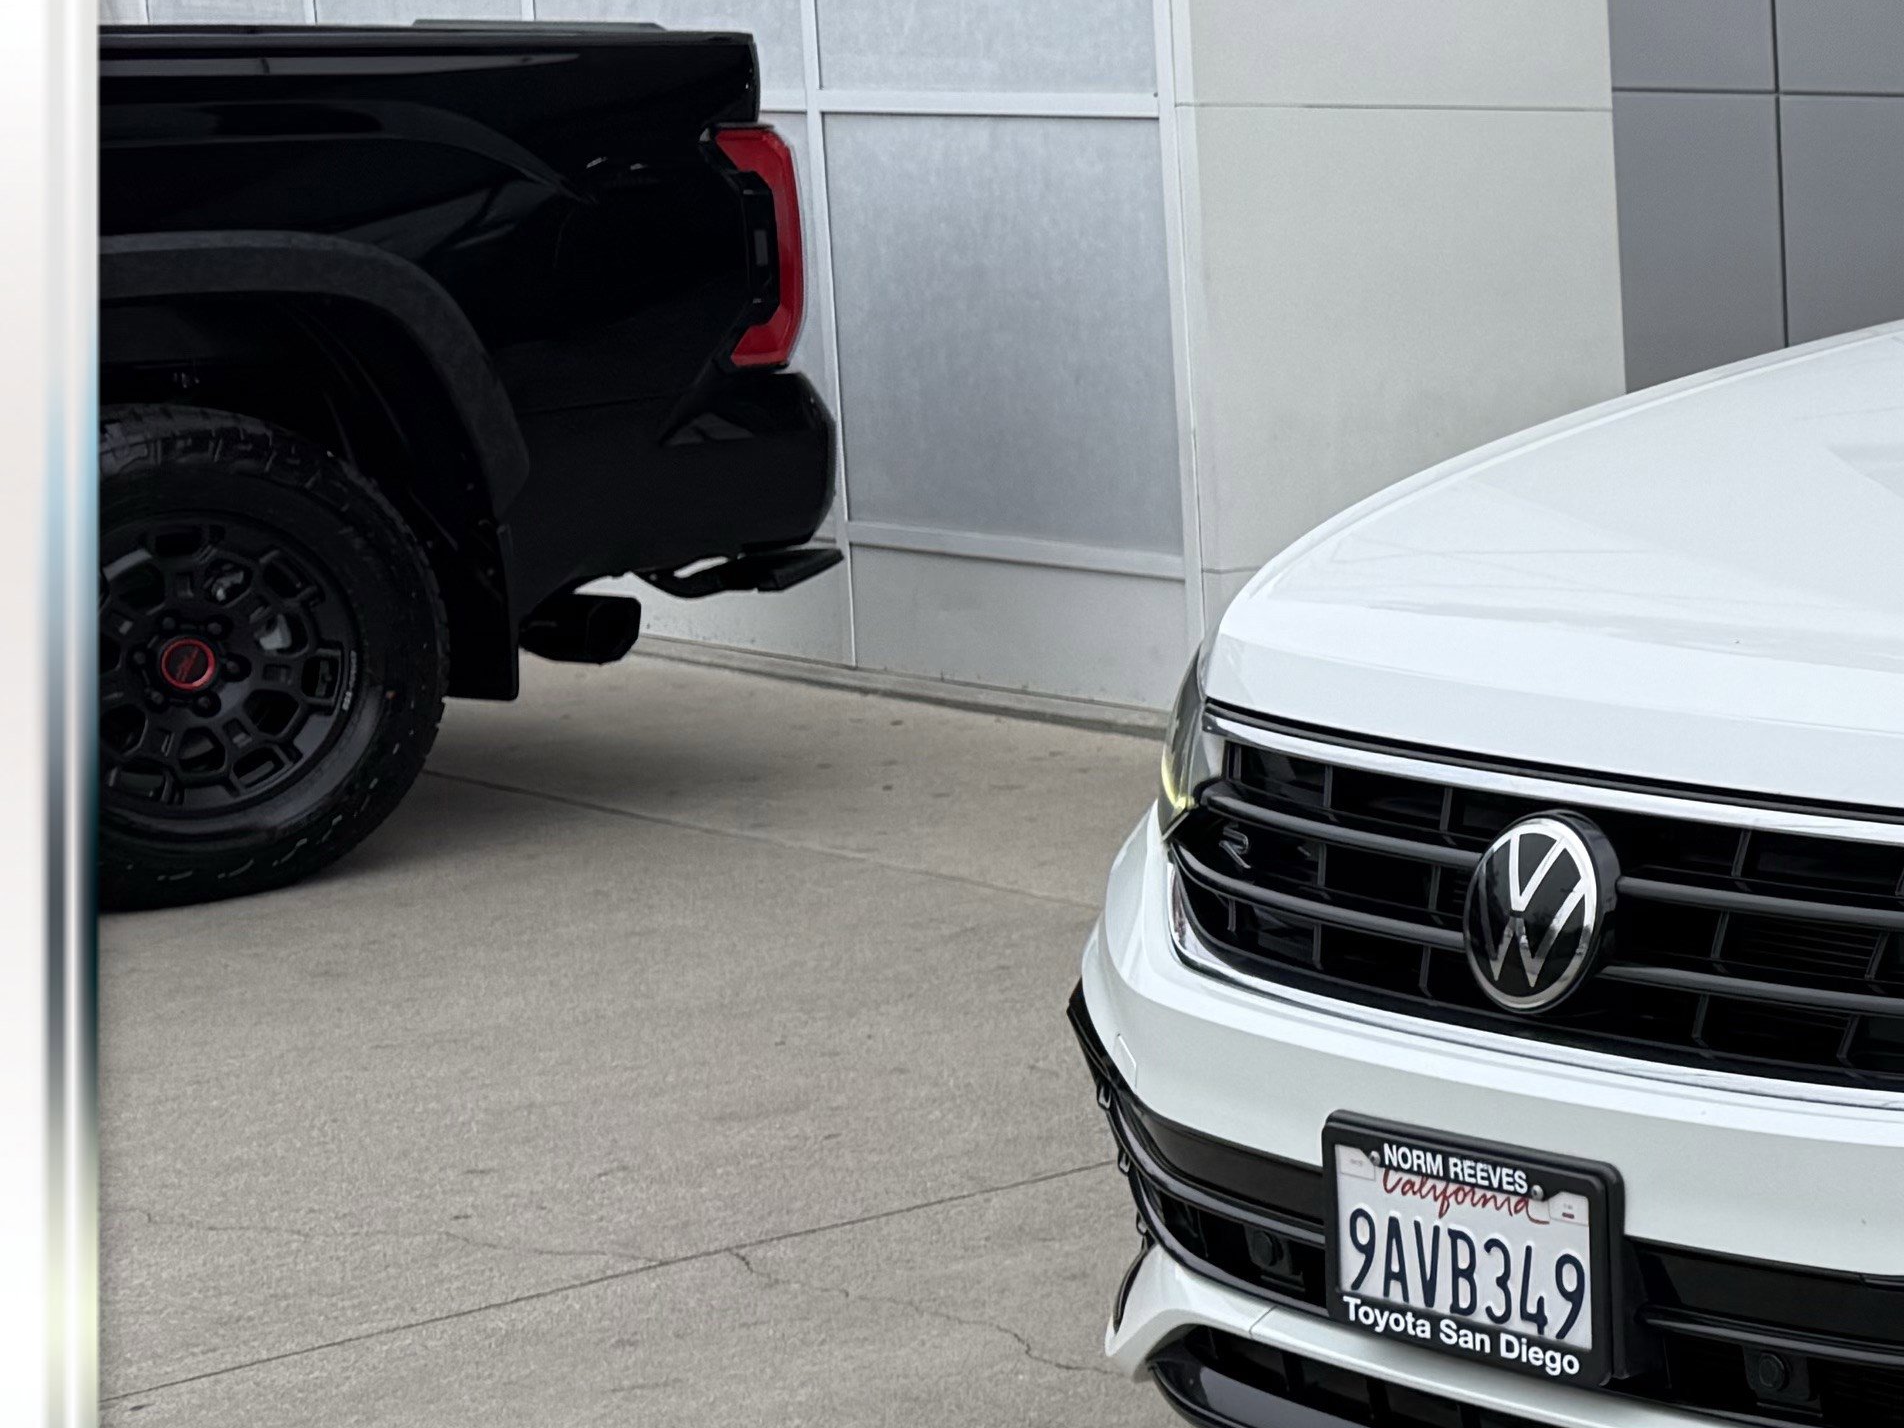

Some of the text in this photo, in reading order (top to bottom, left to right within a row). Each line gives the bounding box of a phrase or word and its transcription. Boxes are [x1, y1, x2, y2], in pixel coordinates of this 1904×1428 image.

[1382, 1142, 1528, 1195] NORM REEVES
[1382, 1168, 1551, 1225] California
[1349, 1207, 1586, 1340] 9AVB349
[1342, 1295, 1580, 1376] Toyota San Diego
